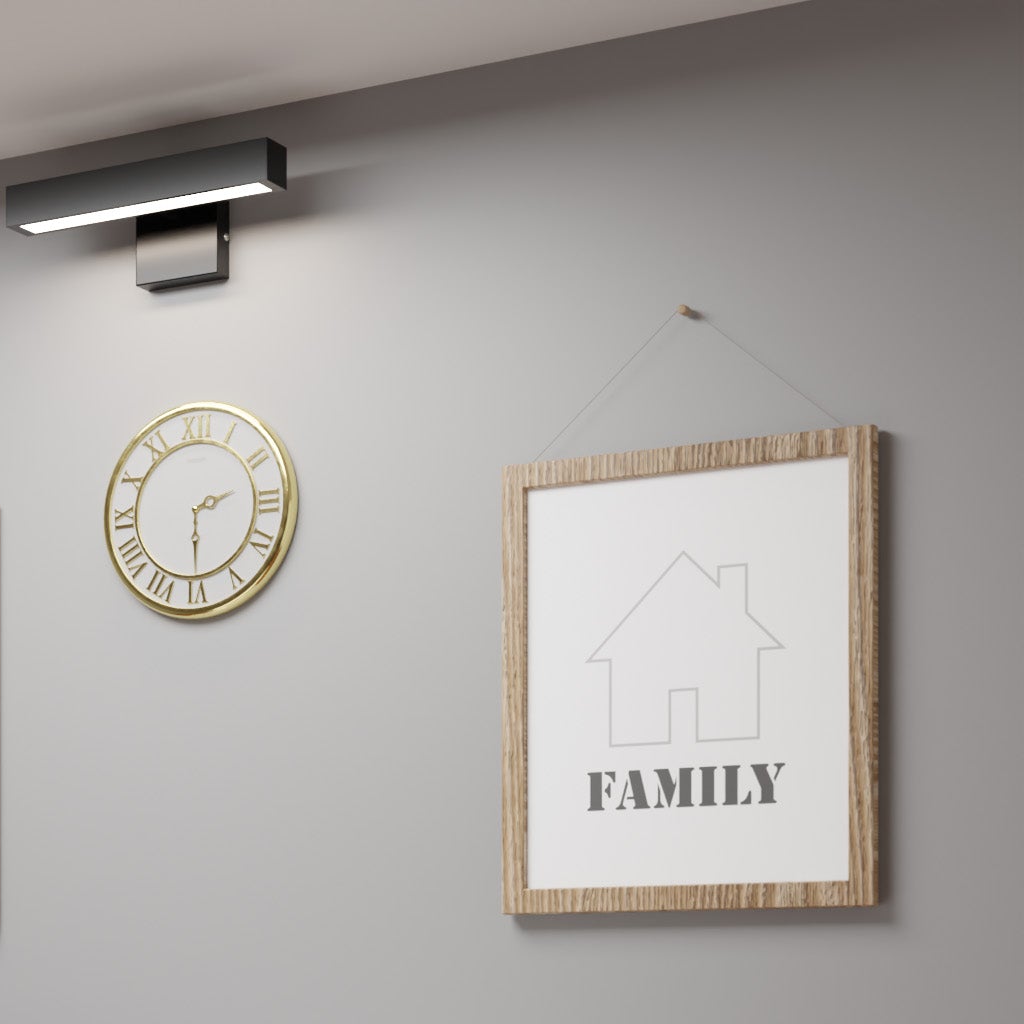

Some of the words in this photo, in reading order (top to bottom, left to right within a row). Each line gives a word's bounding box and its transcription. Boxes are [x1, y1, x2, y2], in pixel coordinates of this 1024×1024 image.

[181, 414, 211, 440] XII
[143, 430, 170, 461] XI
[122, 471, 143, 489] X
[259, 488, 279, 514] III
[249, 529, 273, 556] IV
[229, 567, 244, 589] V
[188, 581, 208, 603] VI
[587, 762, 786, 812] FAMILY
